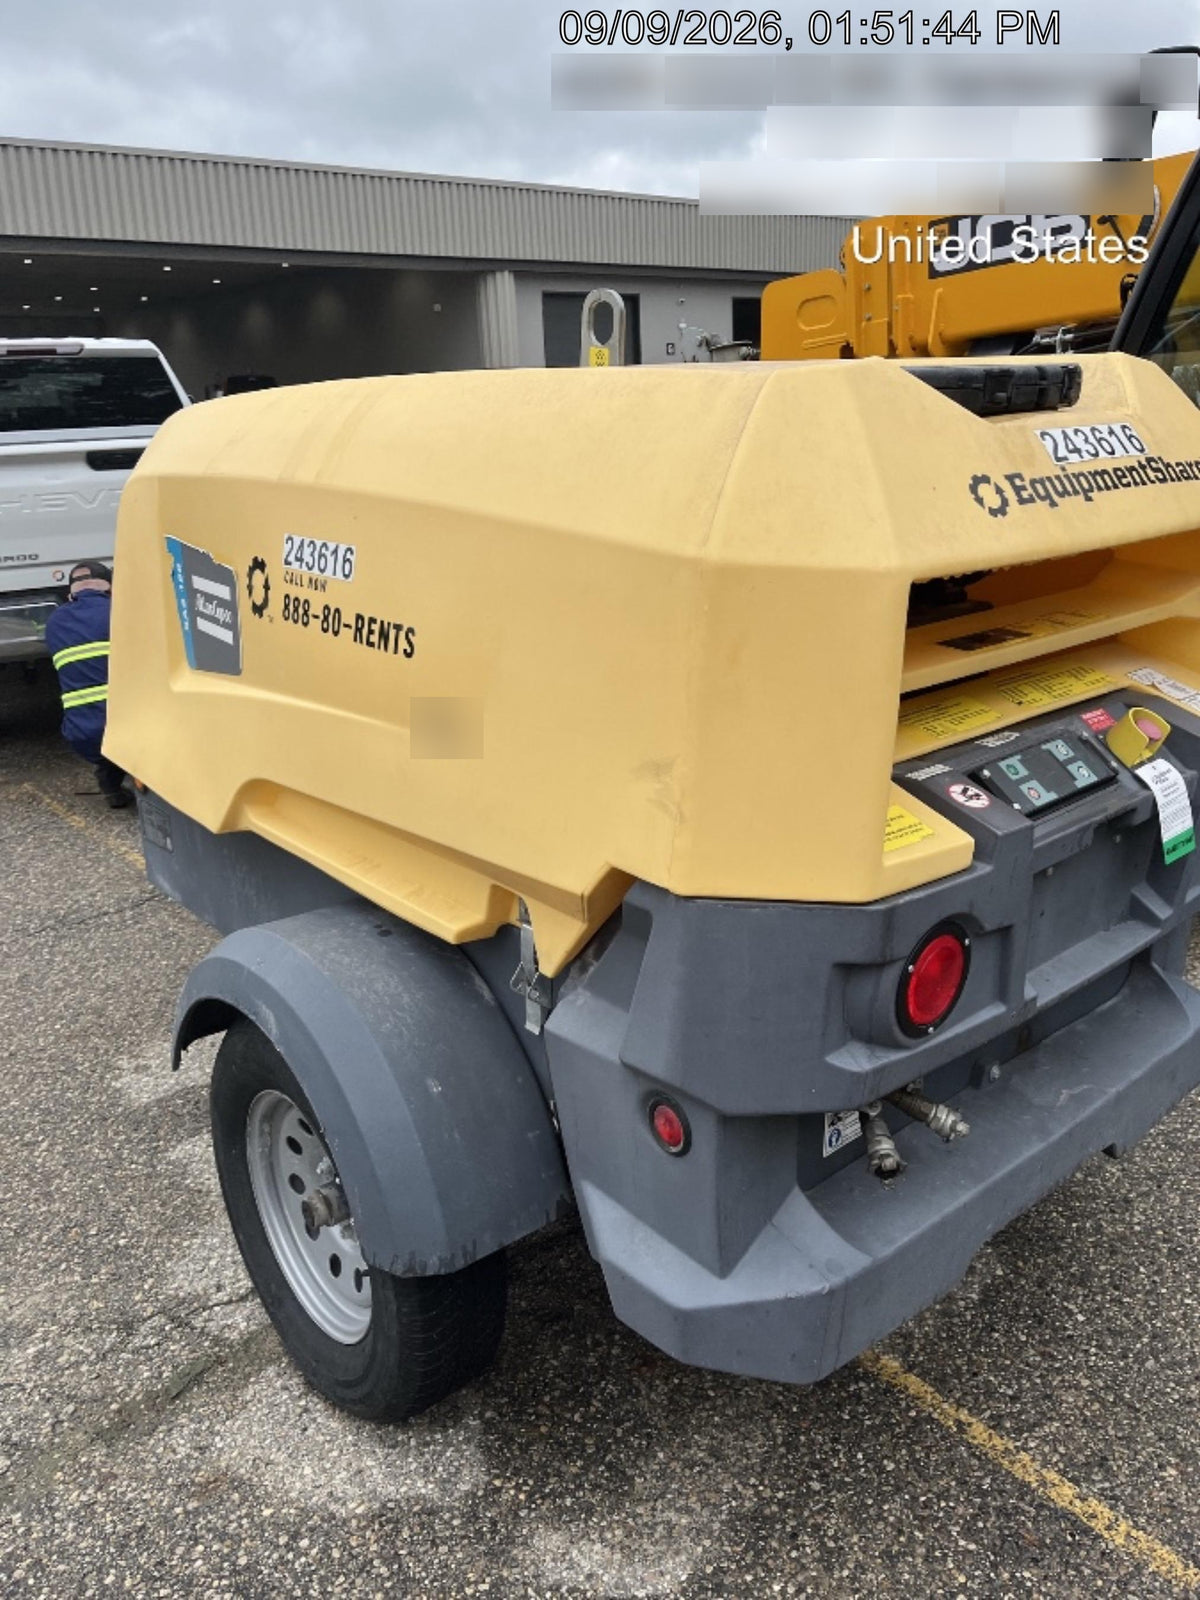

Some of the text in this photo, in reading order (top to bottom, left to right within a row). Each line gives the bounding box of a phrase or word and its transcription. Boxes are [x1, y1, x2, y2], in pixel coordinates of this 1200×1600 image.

[1040, 424, 1147, 463] 243616
[284, 535, 354, 579] 243616
[284, 570, 304, 588] CALL
[282, 593, 416, 659] 888-80-RENTS
